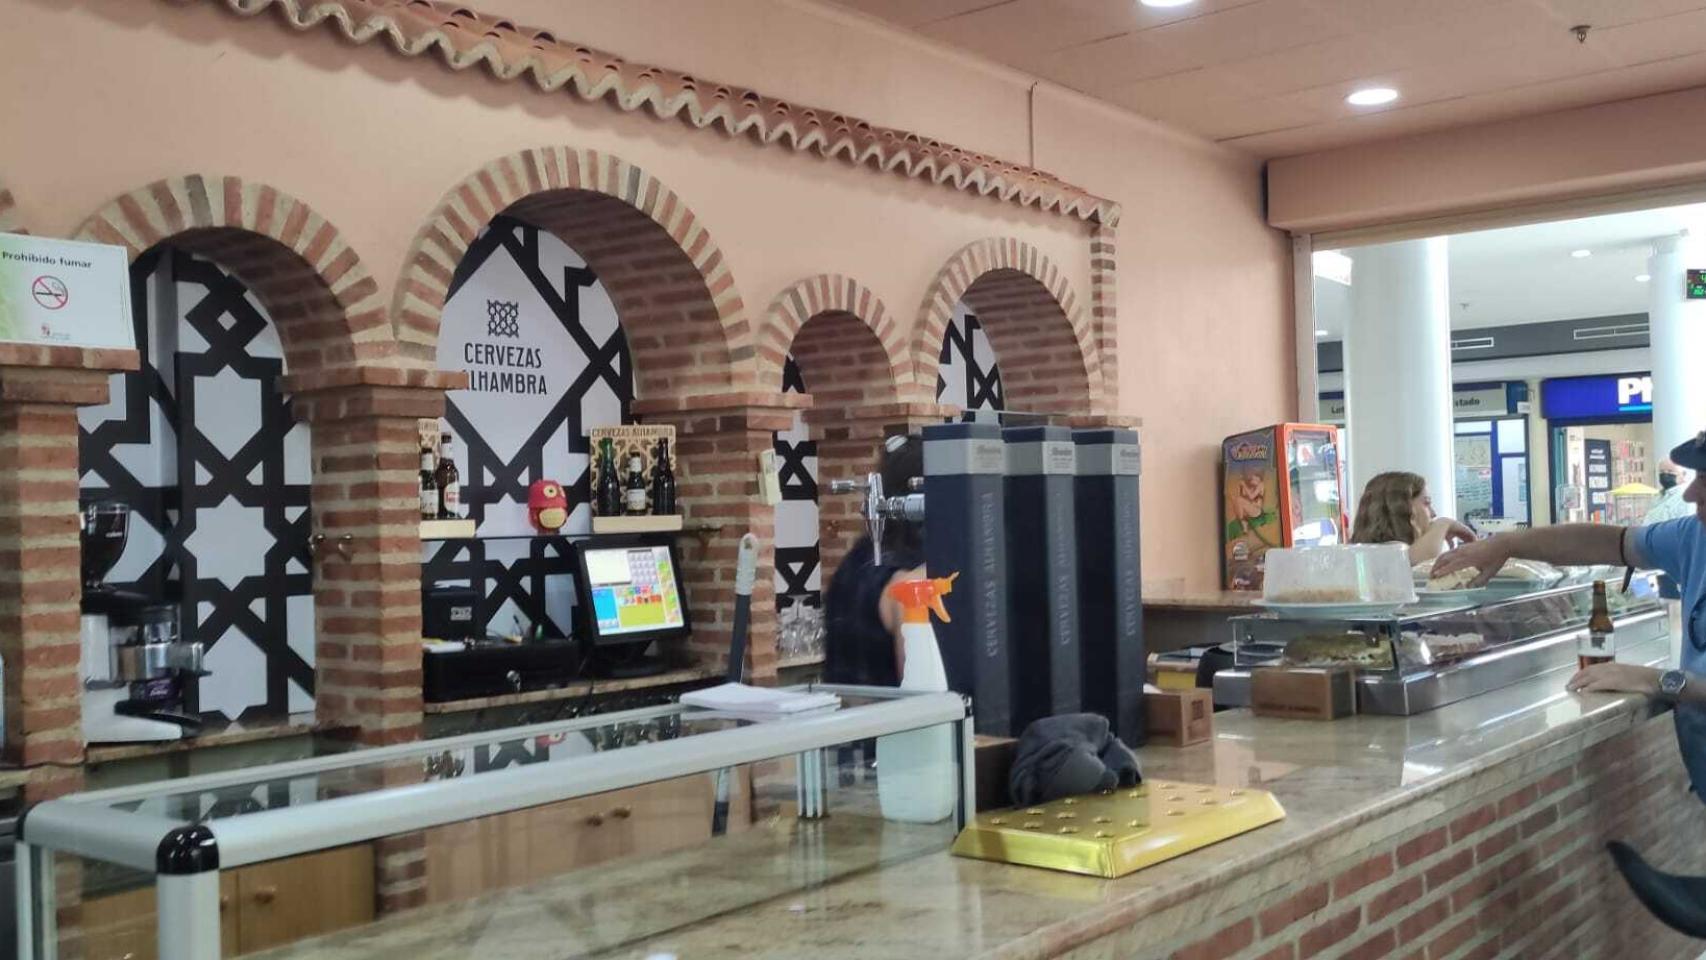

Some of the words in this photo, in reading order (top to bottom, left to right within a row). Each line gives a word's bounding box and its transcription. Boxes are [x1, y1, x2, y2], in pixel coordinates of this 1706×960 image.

[2, 251, 56, 265] Prohibido
[60, 257, 92, 268] fumar
[464, 342, 542, 369] CERVEZAS
[463, 370, 547, 396] LHAMBRA
